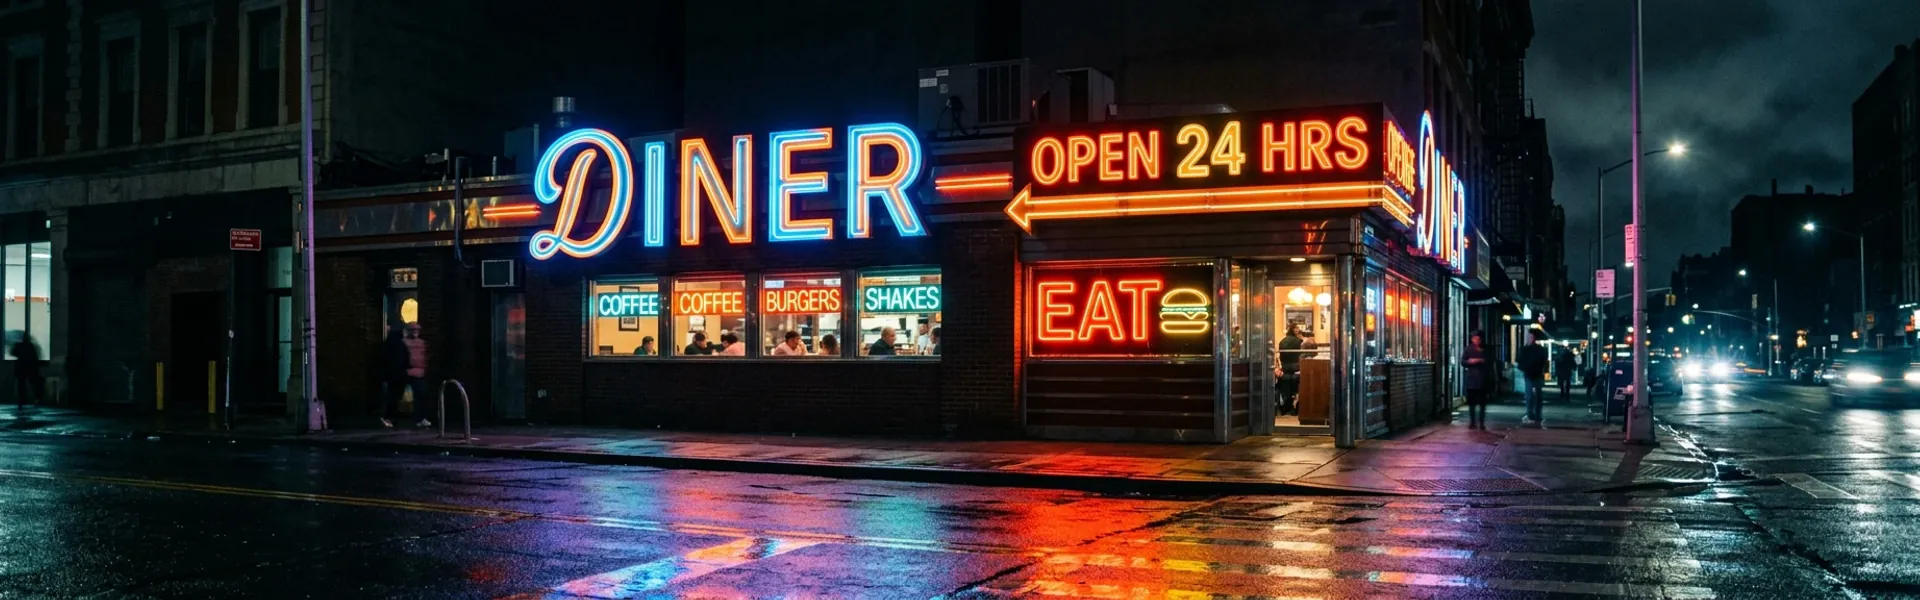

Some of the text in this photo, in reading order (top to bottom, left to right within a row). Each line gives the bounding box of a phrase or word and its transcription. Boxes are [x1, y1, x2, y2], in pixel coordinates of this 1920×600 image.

[1031, 115, 1370, 186] OPEN 24 HRS
[529, 122, 929, 261] DINER
[1416, 109, 1466, 275] DINER
[599, 293, 659, 316] COFFEE
[680, 291, 743, 314] COFFEE
[766, 288, 841, 312] BURGERS
[865, 286, 940, 311] SHAKES
[1037, 279, 1162, 341] EAT
